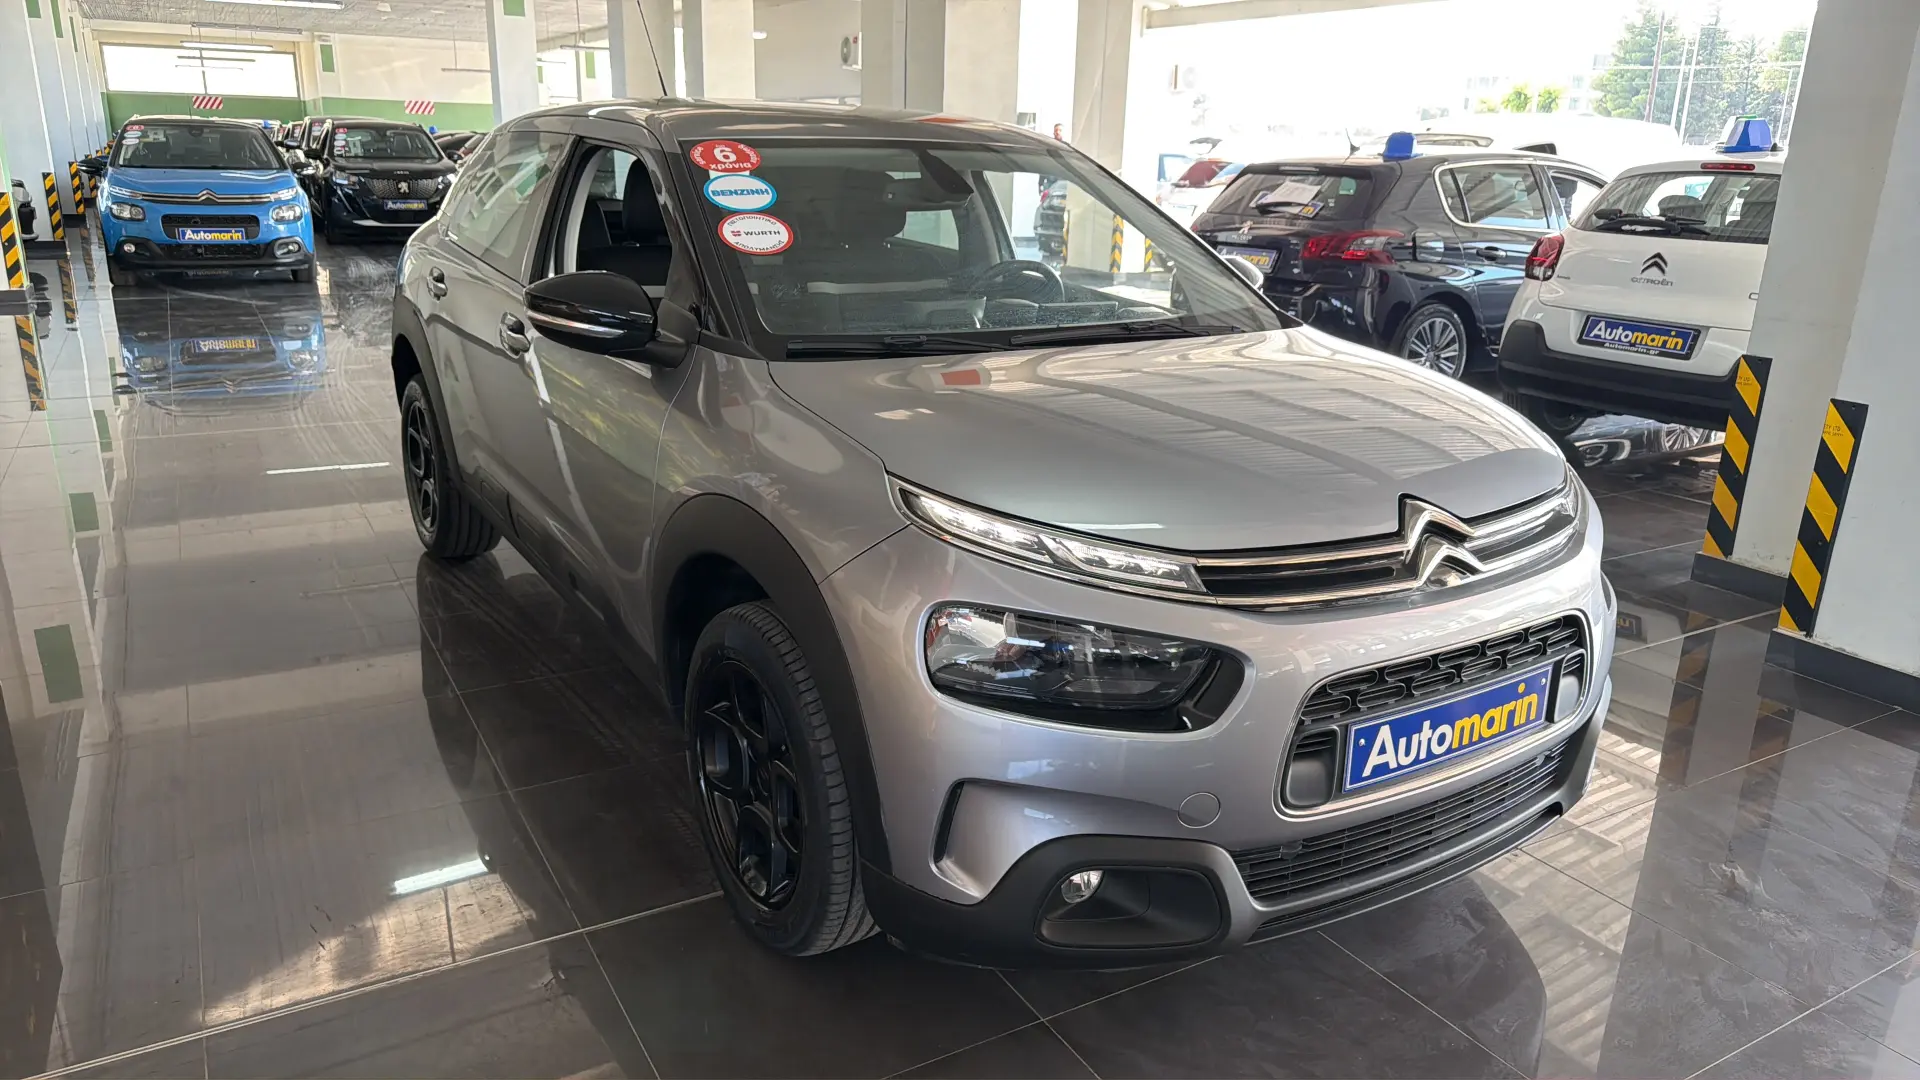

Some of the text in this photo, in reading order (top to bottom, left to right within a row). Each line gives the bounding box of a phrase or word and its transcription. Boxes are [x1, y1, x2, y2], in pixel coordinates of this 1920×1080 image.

[714, 147, 737, 163] 6
[709, 161, 752, 170] χρόνια
[387, 201, 425, 209] Automarin
[184, 229, 242, 240] Automarin
[1589, 320, 1683, 350] Automarin
[1604, 342, 1659, 355] Automarin.gr
[1362, 682, 1538, 778] Automarin
